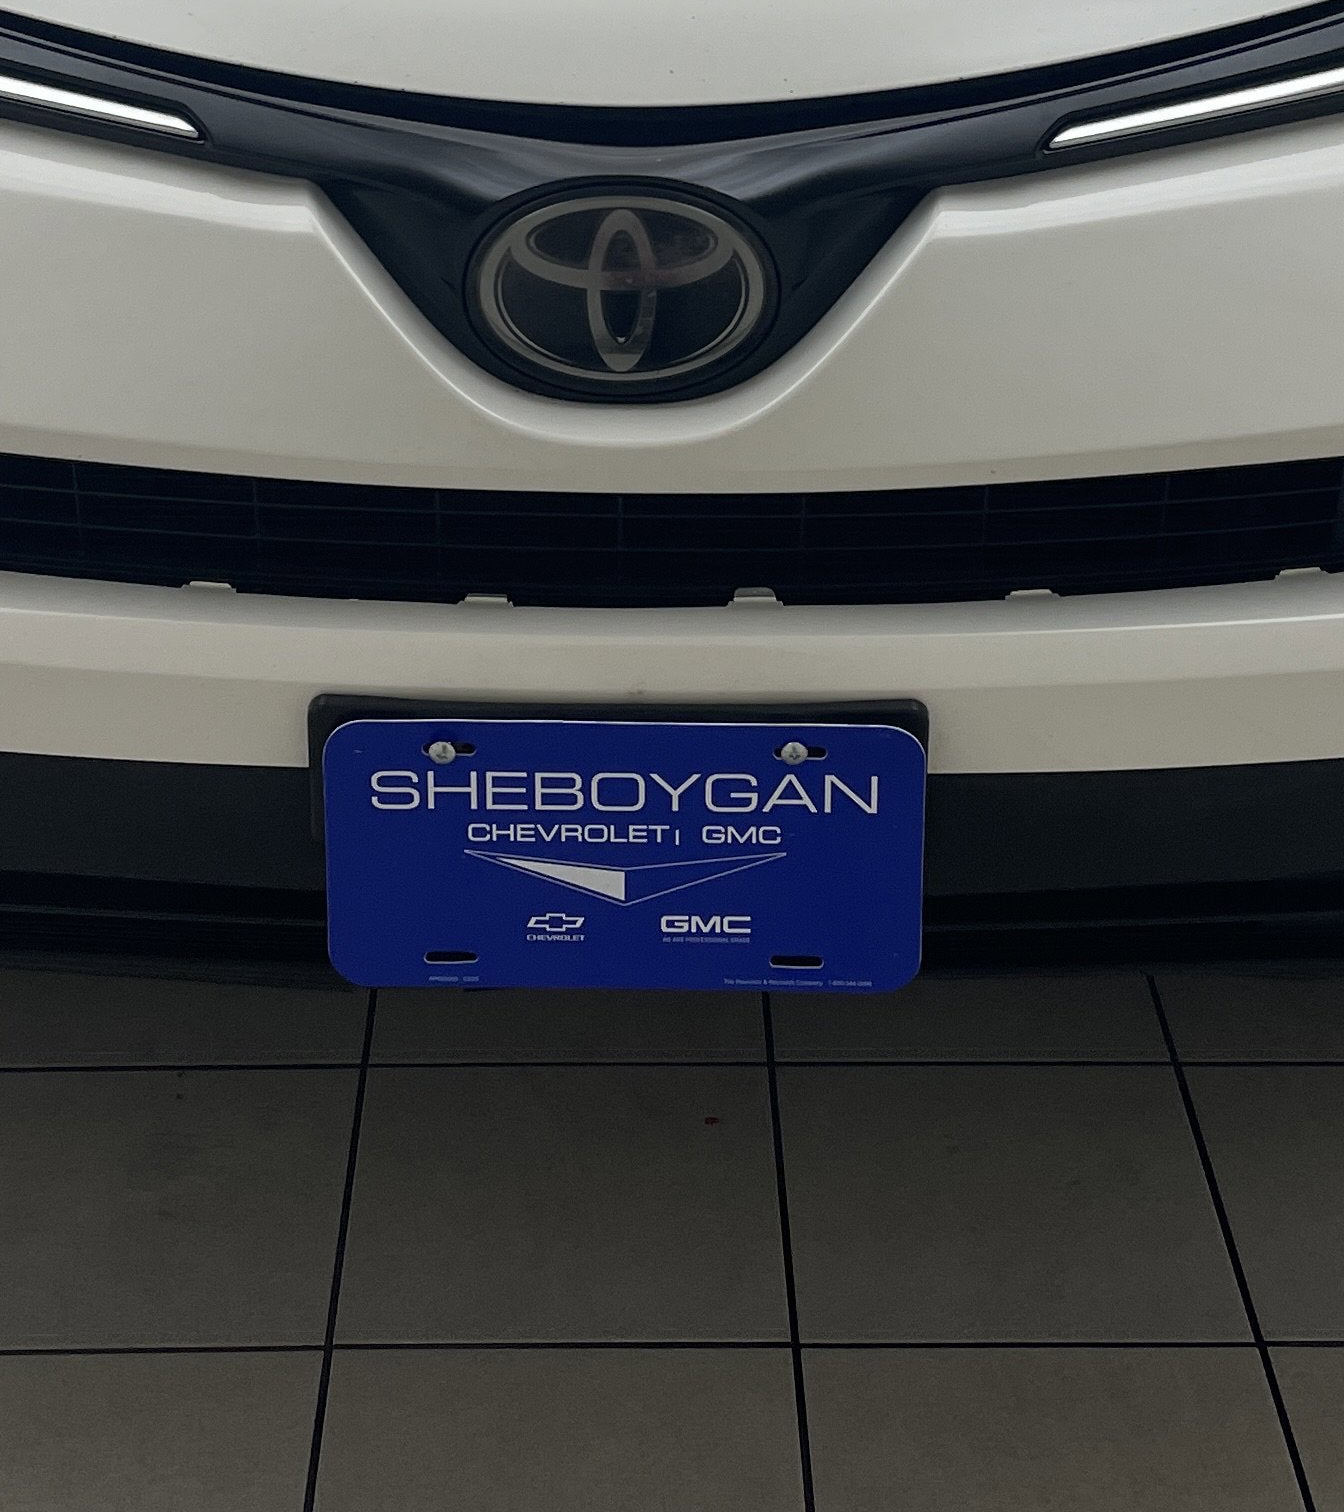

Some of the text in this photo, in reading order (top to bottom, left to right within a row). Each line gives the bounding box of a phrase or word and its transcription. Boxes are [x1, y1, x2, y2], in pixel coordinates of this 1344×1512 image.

[370, 770, 879, 814] SHEBOYGAN
[467, 823, 782, 845] CHEVROLET GMC
[660, 915, 752, 934] GMC
[526, 934, 585, 942] CHEVROLET
